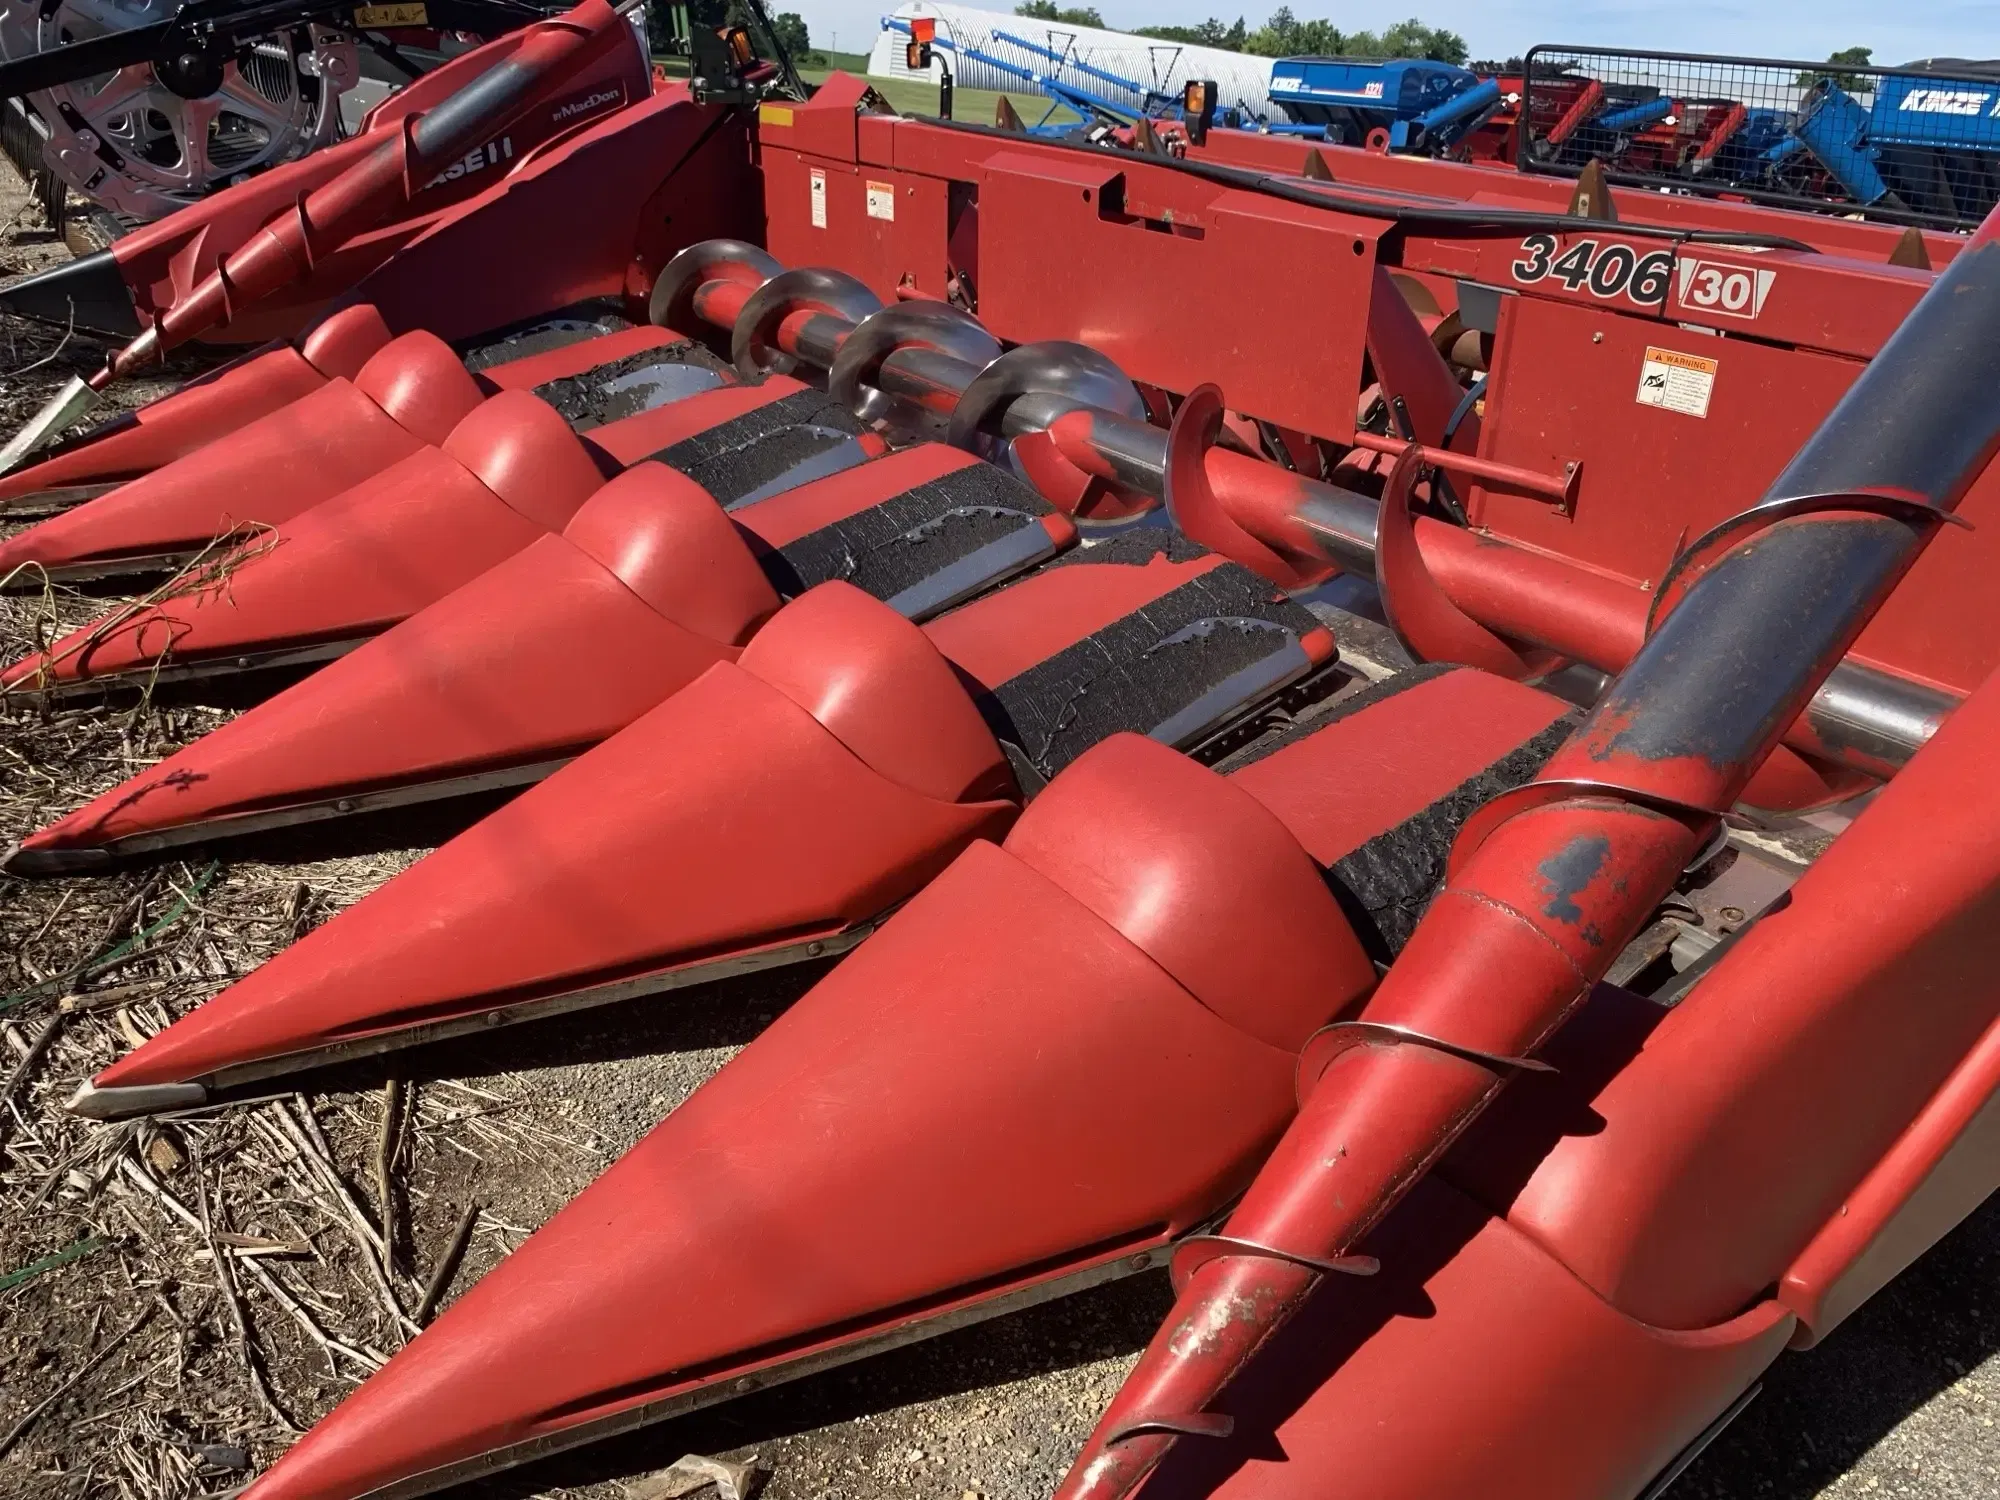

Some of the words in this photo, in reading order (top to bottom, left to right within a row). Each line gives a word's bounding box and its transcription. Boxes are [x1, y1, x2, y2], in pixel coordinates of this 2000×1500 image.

[561, 89, 619, 117] MacDon
[1899, 88, 1991, 116] KINZE
[1512, 234, 1679, 306] 3406
[1693, 269, 1751, 310] 30
[1666, 354, 1707, 370] WARNING
